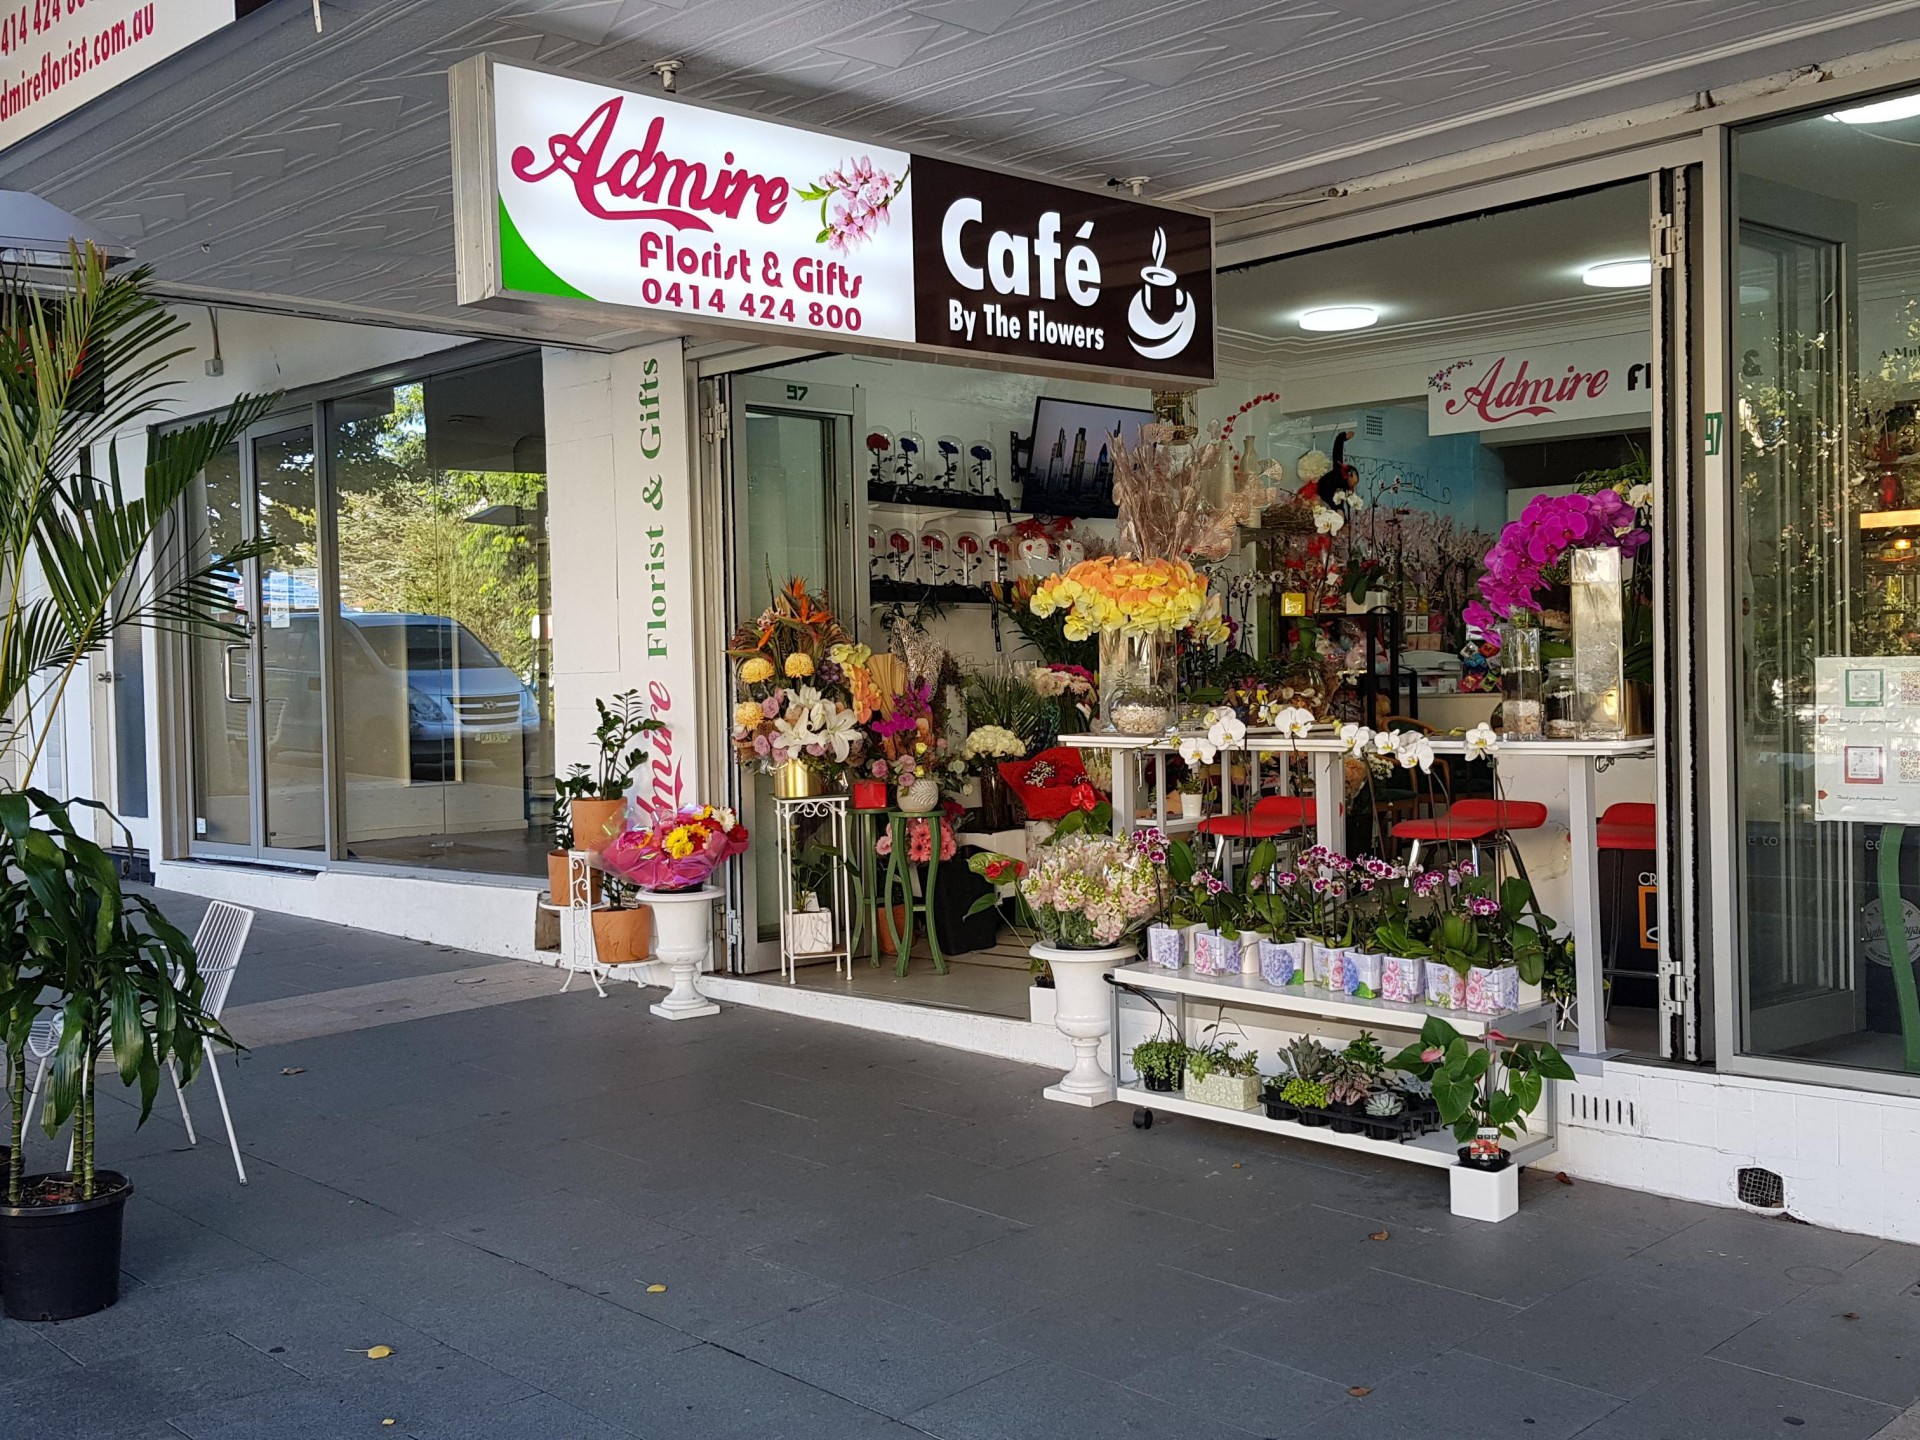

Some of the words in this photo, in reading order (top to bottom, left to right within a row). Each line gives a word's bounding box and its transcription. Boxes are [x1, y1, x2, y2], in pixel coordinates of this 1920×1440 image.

[511, 96, 790, 233] Admire
[639, 231, 751, 283] Florist
[761, 251, 783, 288] &
[792, 256, 863, 299] Gifts
[941, 198, 1102, 307] Café
[641, 277, 726, 313] 0414
[739, 292, 796, 323] 424
[808, 301, 862, 332] 800
[949, 298, 976, 342] By
[983, 303, 1021, 340] The
[1028, 310, 1105, 351] Flowers
[639, 358, 662, 460] Gifts
[786, 384, 808, 401] 97
[1445, 356, 1609, 423] Admire
[1705, 411, 1723, 456] 97
[642, 474, 663, 511] &
[645, 524, 668, 660] Florist
[637, 680, 684, 818] mire
